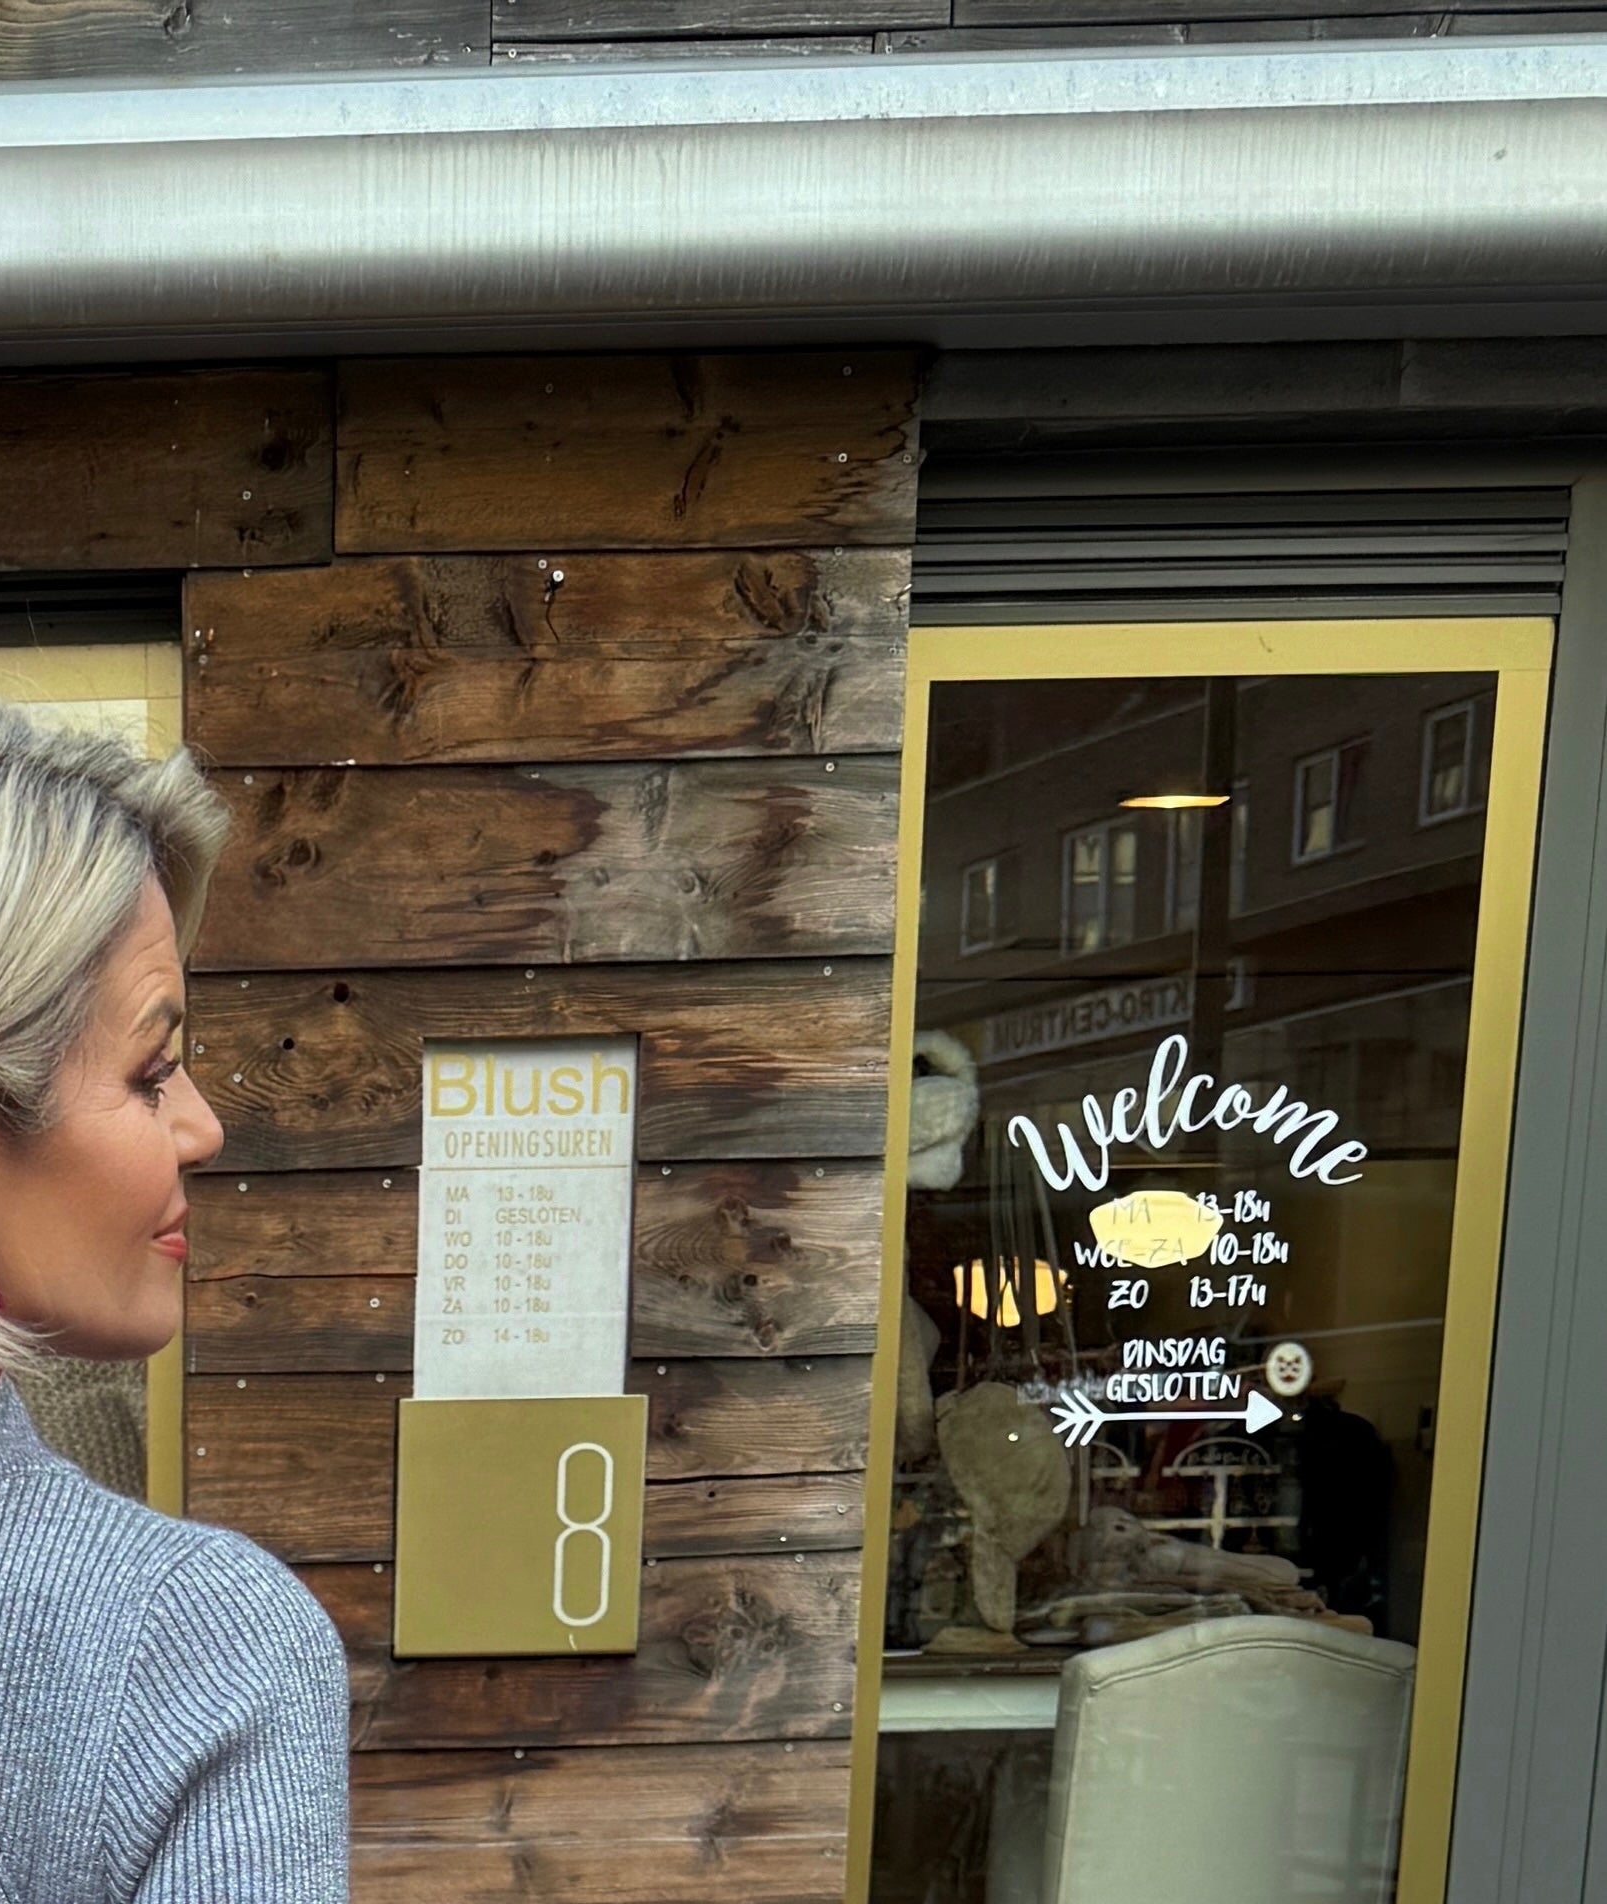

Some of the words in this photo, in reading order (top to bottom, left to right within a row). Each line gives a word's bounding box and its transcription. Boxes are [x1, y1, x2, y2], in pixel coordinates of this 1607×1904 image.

[430, 1052, 630, 1117] Blush
[1007, 1034, 1368, 1192] Welcome
[444, 1129, 613, 1159] OPENINGSUREN
[446, 1186, 470, 1202] MA
[497, 1186, 514, 1201] 13
[529, 1184, 554, 1202] 18u
[1113, 1197, 1151, 1224] MA
[1195, 1190, 1270, 1223] 13-18u
[445, 1208, 461, 1225] DI
[495, 1207, 581, 1225] GESLOTEN
[444, 1231, 472, 1247] WO
[496, 1231, 512, 1247] 10
[527, 1230, 553, 1247] 18u
[1210, 1232, 1289, 1265] 10-18u
[444, 1253, 468, 1270] DO
[495, 1253, 511, 1269] 10
[527, 1253, 552, 1269] 18u
[444, 1275, 466, 1292] VR
[494, 1275, 511, 1291] 10
[526, 1275, 551, 1291] 18u
[1107, 1279, 1149, 1310] ZO
[1189, 1274, 1267, 1308] 13-17u
[442, 1298, 463, 1314] ZA
[494, 1297, 510, 1313] 10
[525, 1297, 550, 1313] 18u
[442, 1329, 465, 1345] ZO
[1123, 1337, 1227, 1369] DINSDAG
[1106, 1371, 1242, 1403] GESLOTEN
[552, 1442, 614, 1627] 8
